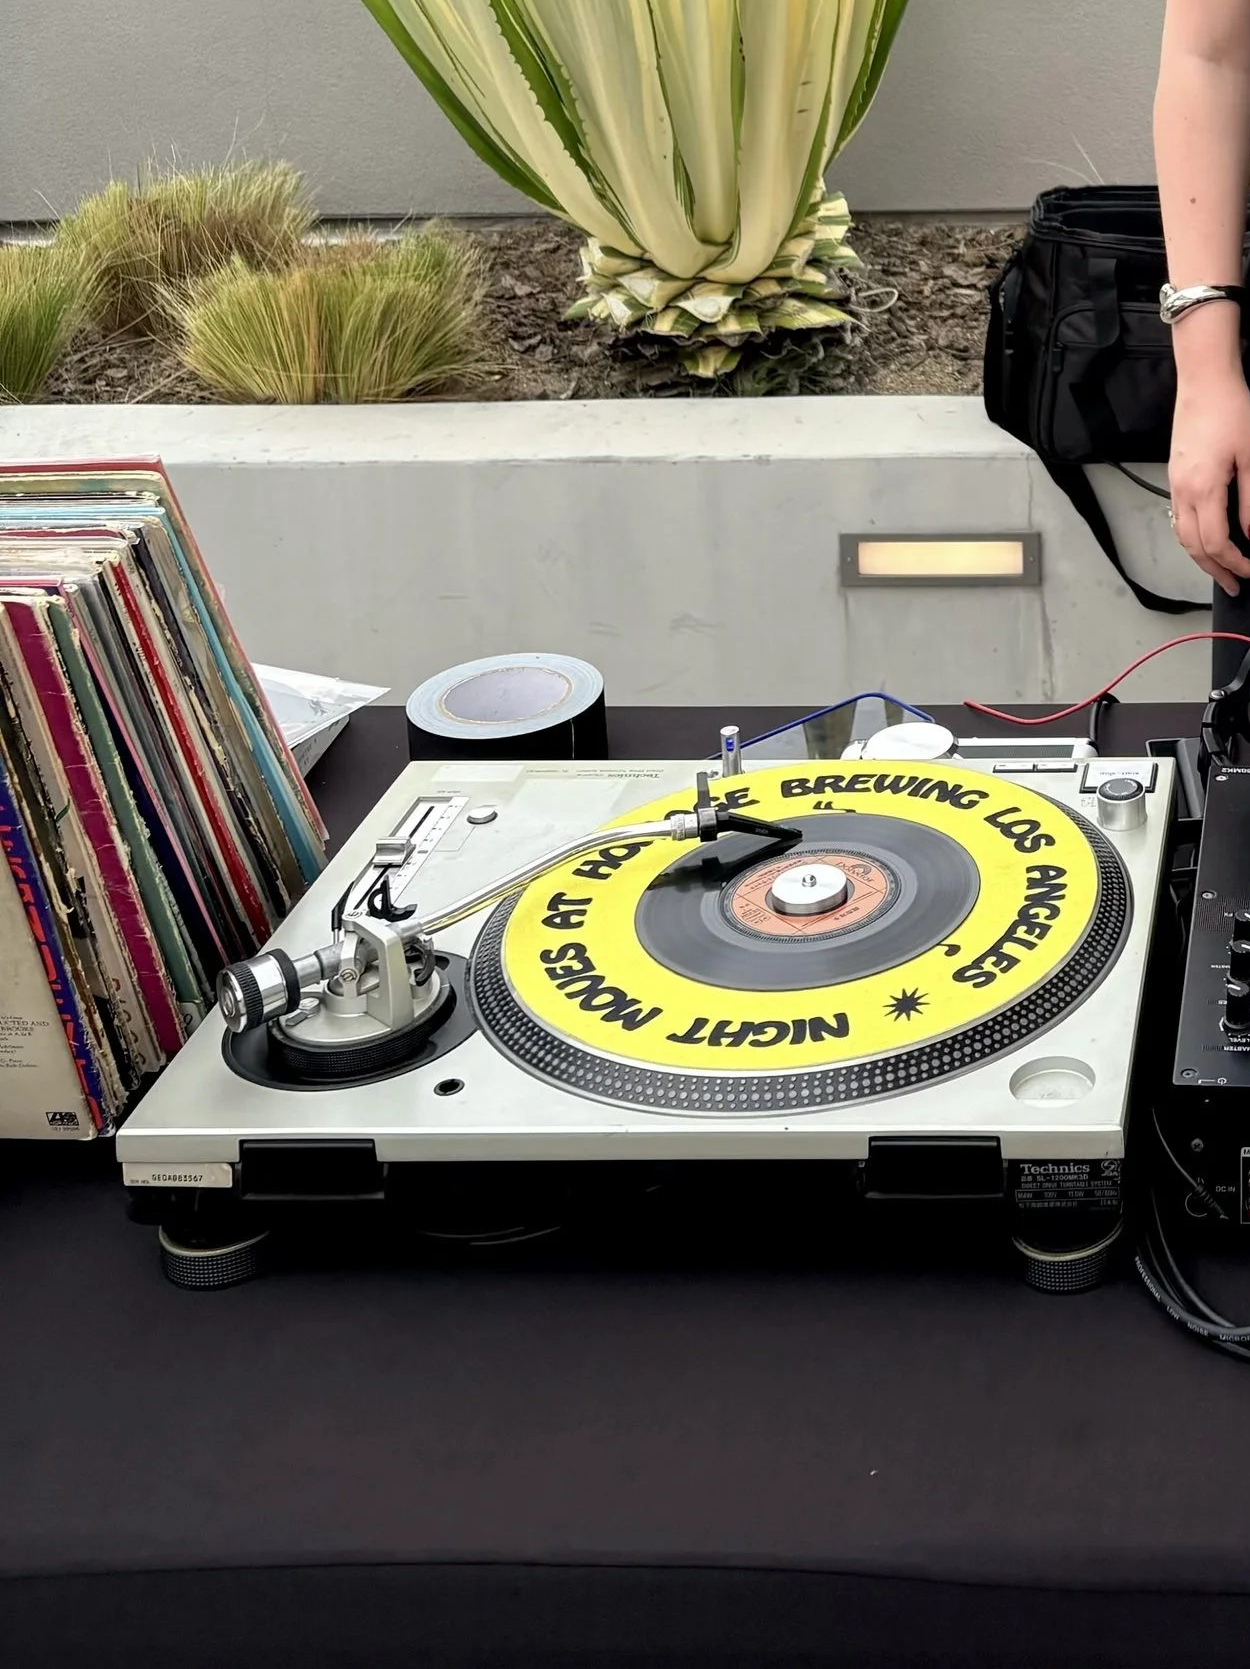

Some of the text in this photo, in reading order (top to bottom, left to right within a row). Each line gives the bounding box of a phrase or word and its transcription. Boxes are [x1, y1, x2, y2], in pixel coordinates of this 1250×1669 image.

[780, 774, 989, 810] BREWING
[983, 806, 1058, 854] LOS
[541, 891, 594, 930] AT
[951, 864, 1062, 990] ANGELES
[539, 942, 663, 1032] MOVES
[668, 1012, 851, 1048] NIGHT
[1020, 1163, 1090, 1174] Technics
[1036, 1173, 1089, 1182] SL-1200MK3D
